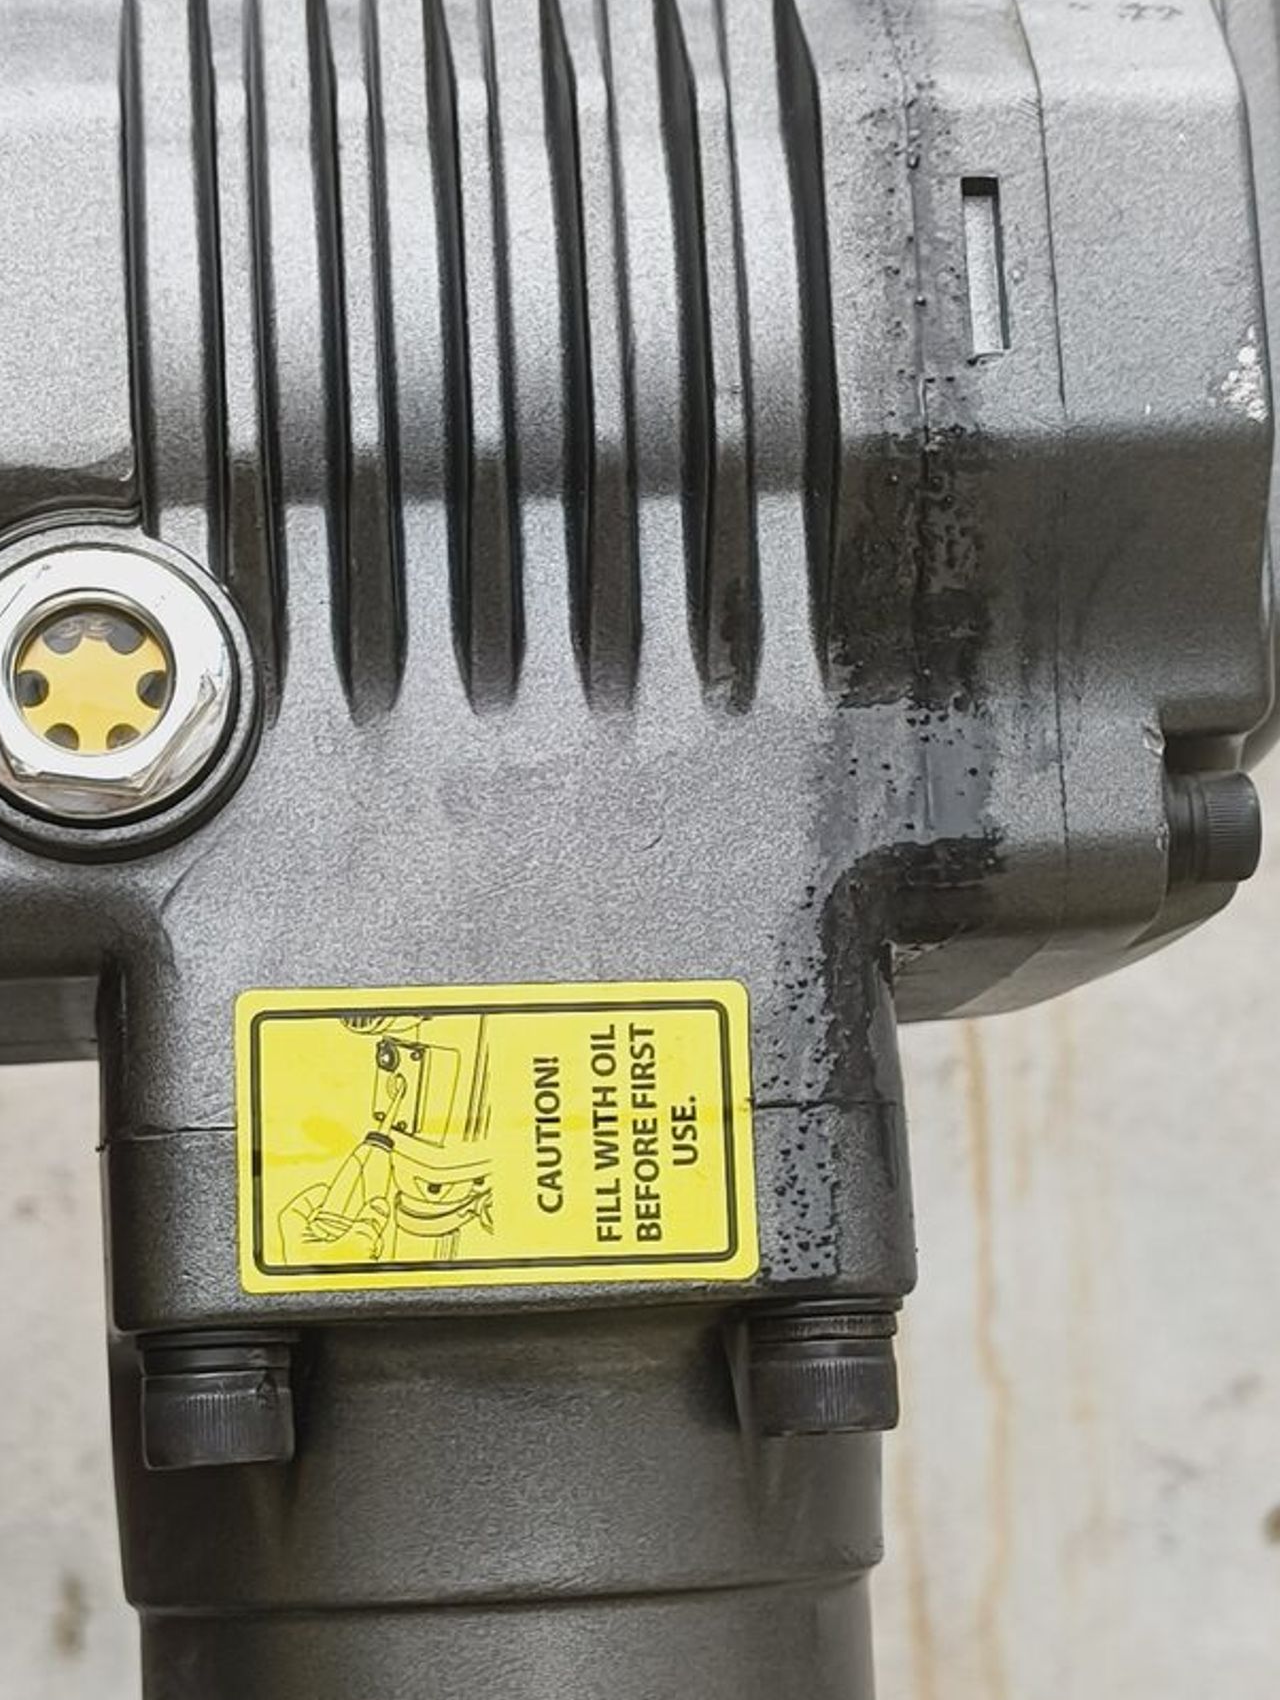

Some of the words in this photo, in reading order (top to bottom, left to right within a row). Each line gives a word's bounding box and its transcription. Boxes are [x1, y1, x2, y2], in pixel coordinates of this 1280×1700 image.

[589, 1022, 618, 1078] OIL
[628, 1021, 657, 1111] FIRST
[532, 1054, 564, 1214] CAUTION!
[592, 1085, 620, 1171] WITH
[670, 1095, 699, 1167] USE.
[596, 1175, 622, 1243] FILL
[631, 1116, 663, 1243] BEFORE
